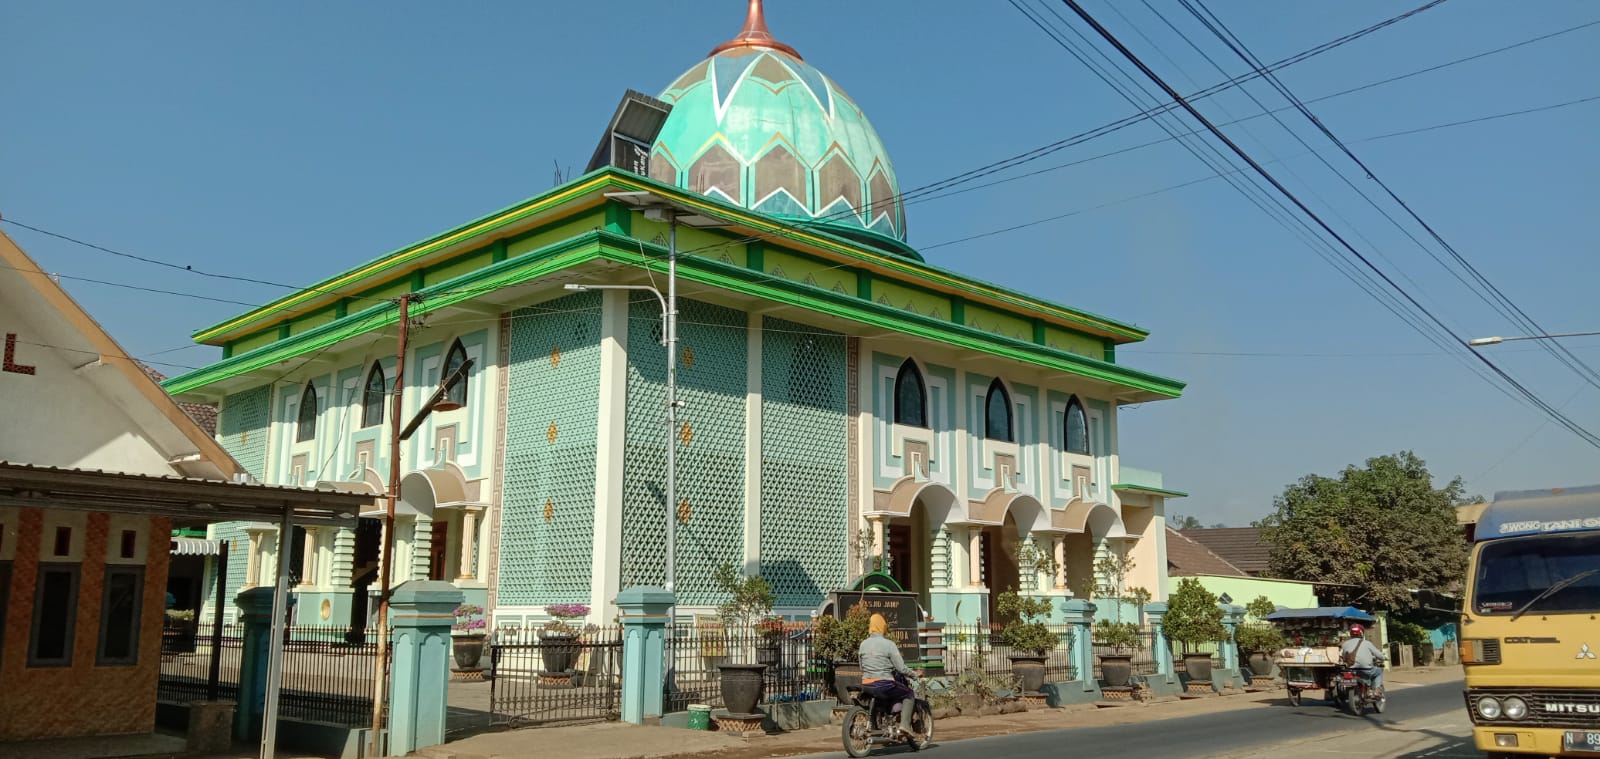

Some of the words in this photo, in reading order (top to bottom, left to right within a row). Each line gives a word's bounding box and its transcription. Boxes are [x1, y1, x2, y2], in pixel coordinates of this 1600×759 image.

[861, 600, 882, 608] ASJID
[1545, 703, 1600, 713] MITSU
[1566, 732, 1574, 744] N
